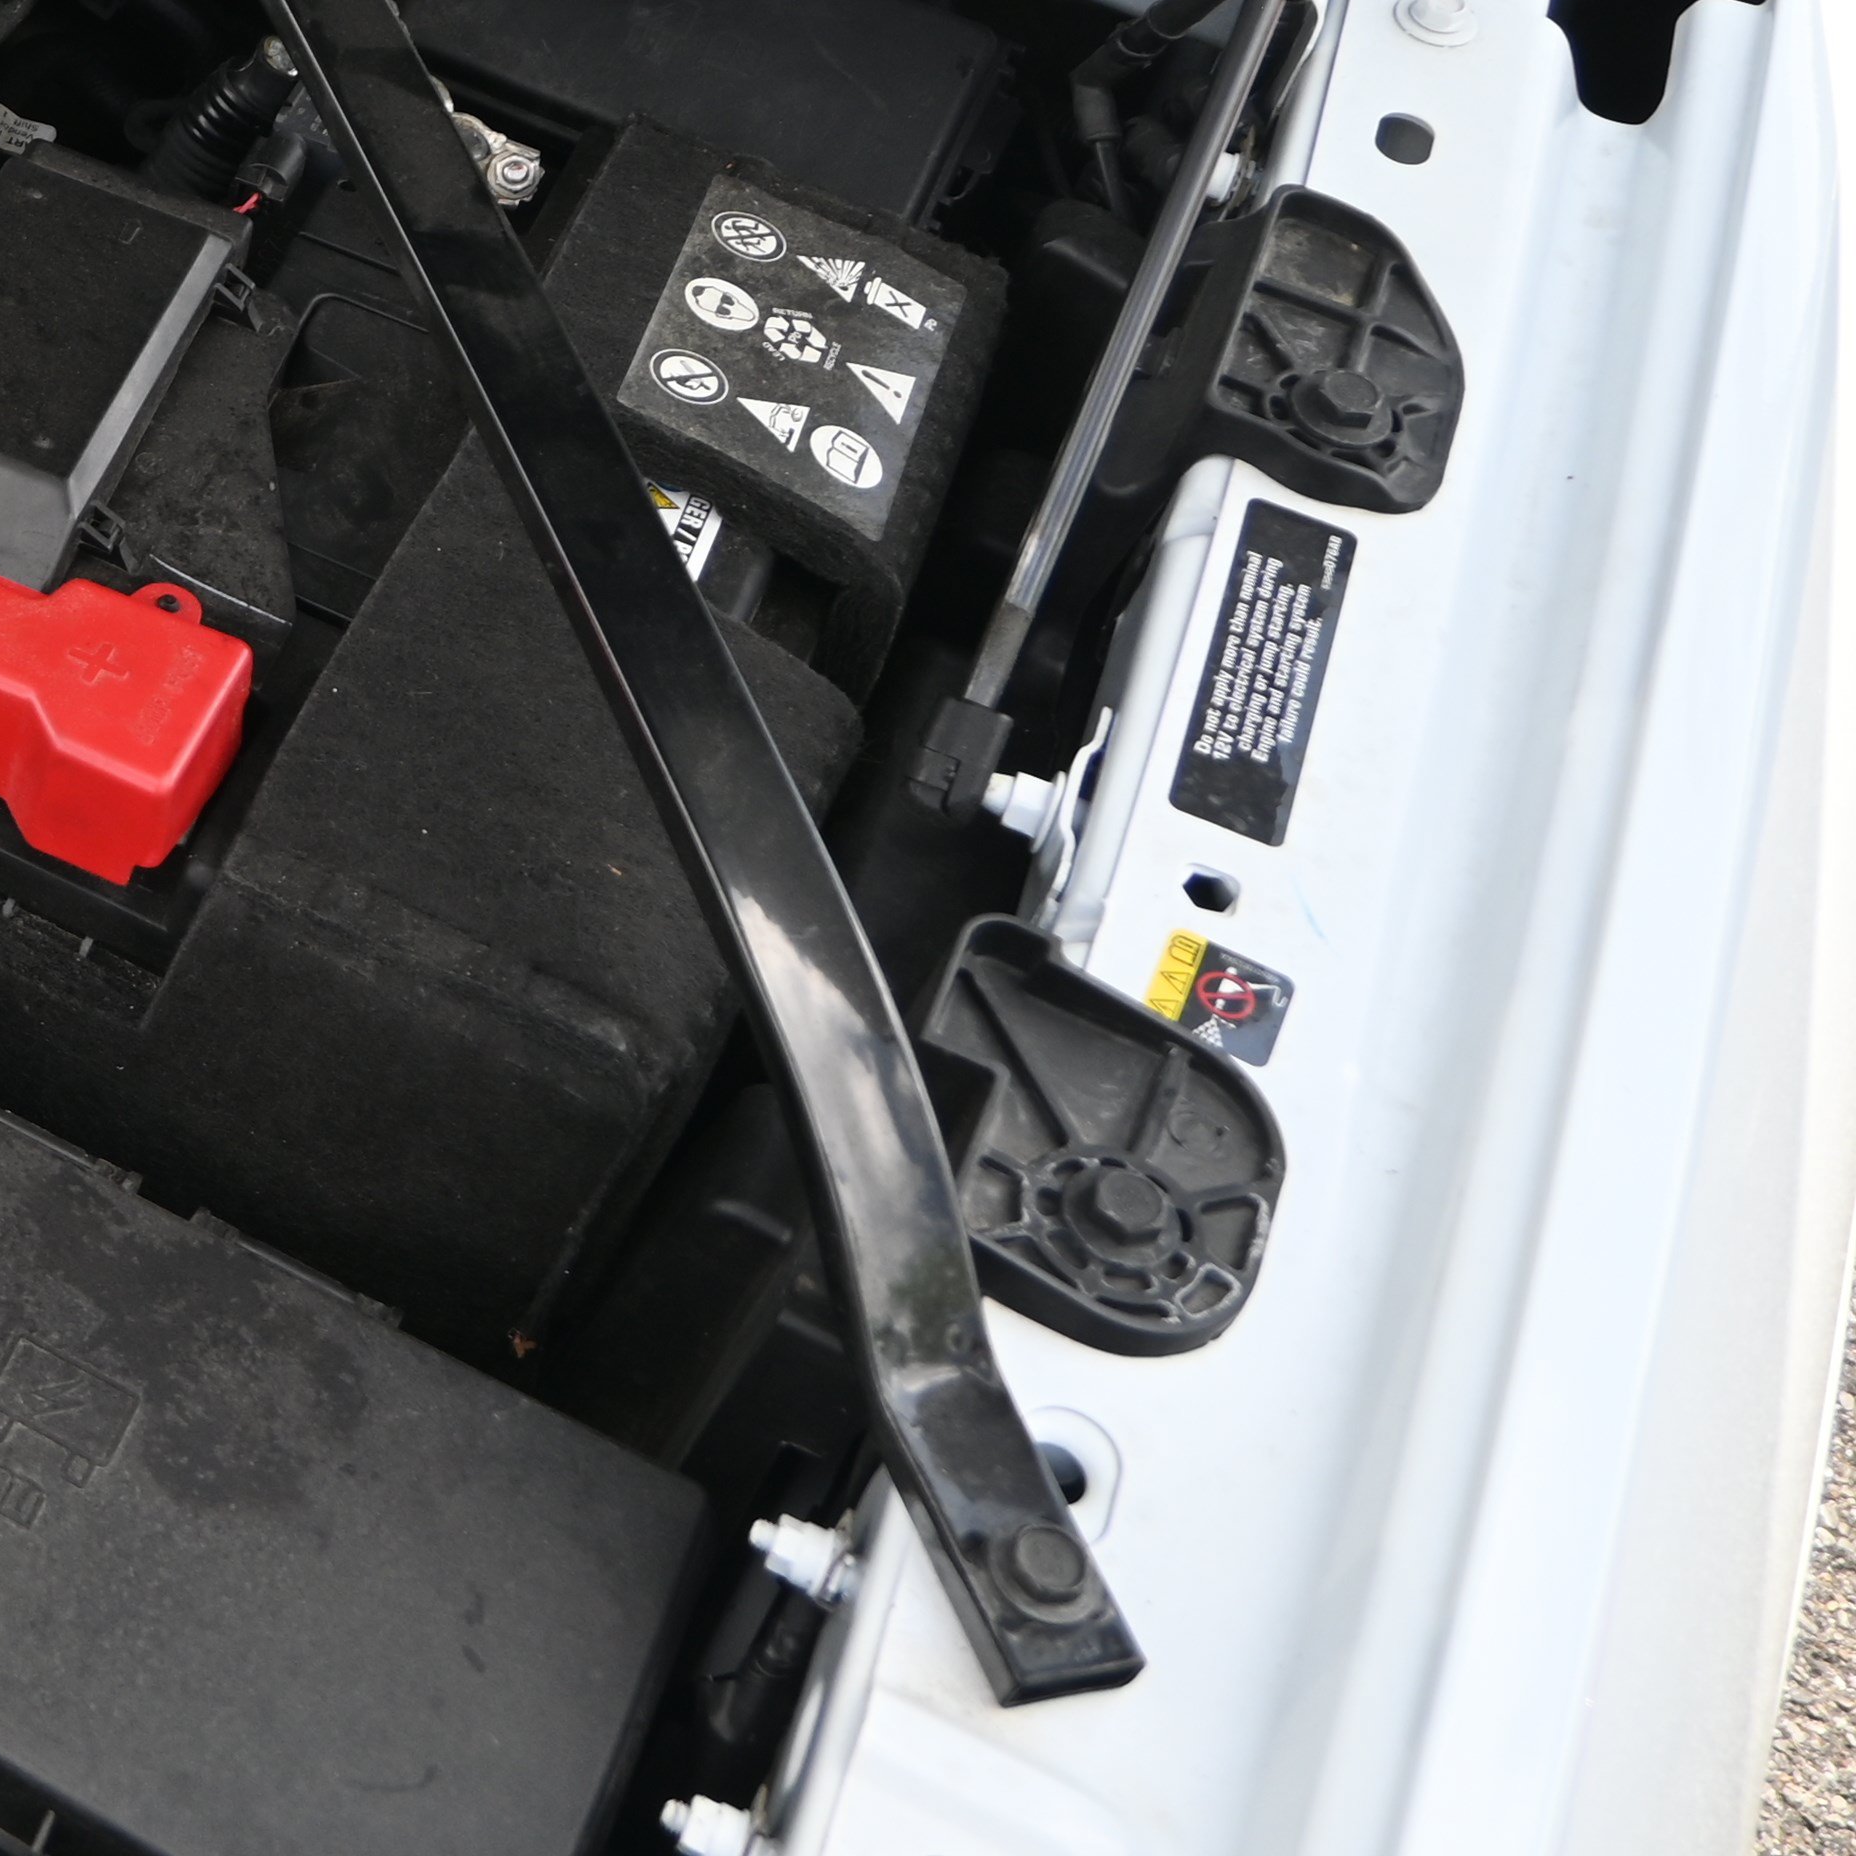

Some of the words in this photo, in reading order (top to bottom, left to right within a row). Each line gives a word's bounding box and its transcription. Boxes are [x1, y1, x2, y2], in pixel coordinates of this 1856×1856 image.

[1236, 550, 1262, 600] nominal
[1257, 556, 1283, 599] during
[1227, 600, 1249, 633] than
[1246, 599, 1274, 648] system
[1287, 583, 1315, 632] system
[1221, 634, 1241, 668] more
[1271, 631, 1302, 688] starting
[1207, 668, 1237, 709] apply
[1225, 647, 1257, 712] electrical
[1235, 691, 1265, 752] charging
[1257, 639, 1282, 674] jump
[1287, 660, 1310, 697] could
[1202, 706, 1221, 732] not
[1222, 712, 1239, 730] to
[1265, 688, 1285, 714] and
[1277, 698, 1303, 744] failure
[1194, 732, 1214, 755] Do
[1213, 730, 1235, 762] 12V
[1252, 714, 1281, 763] Engine
